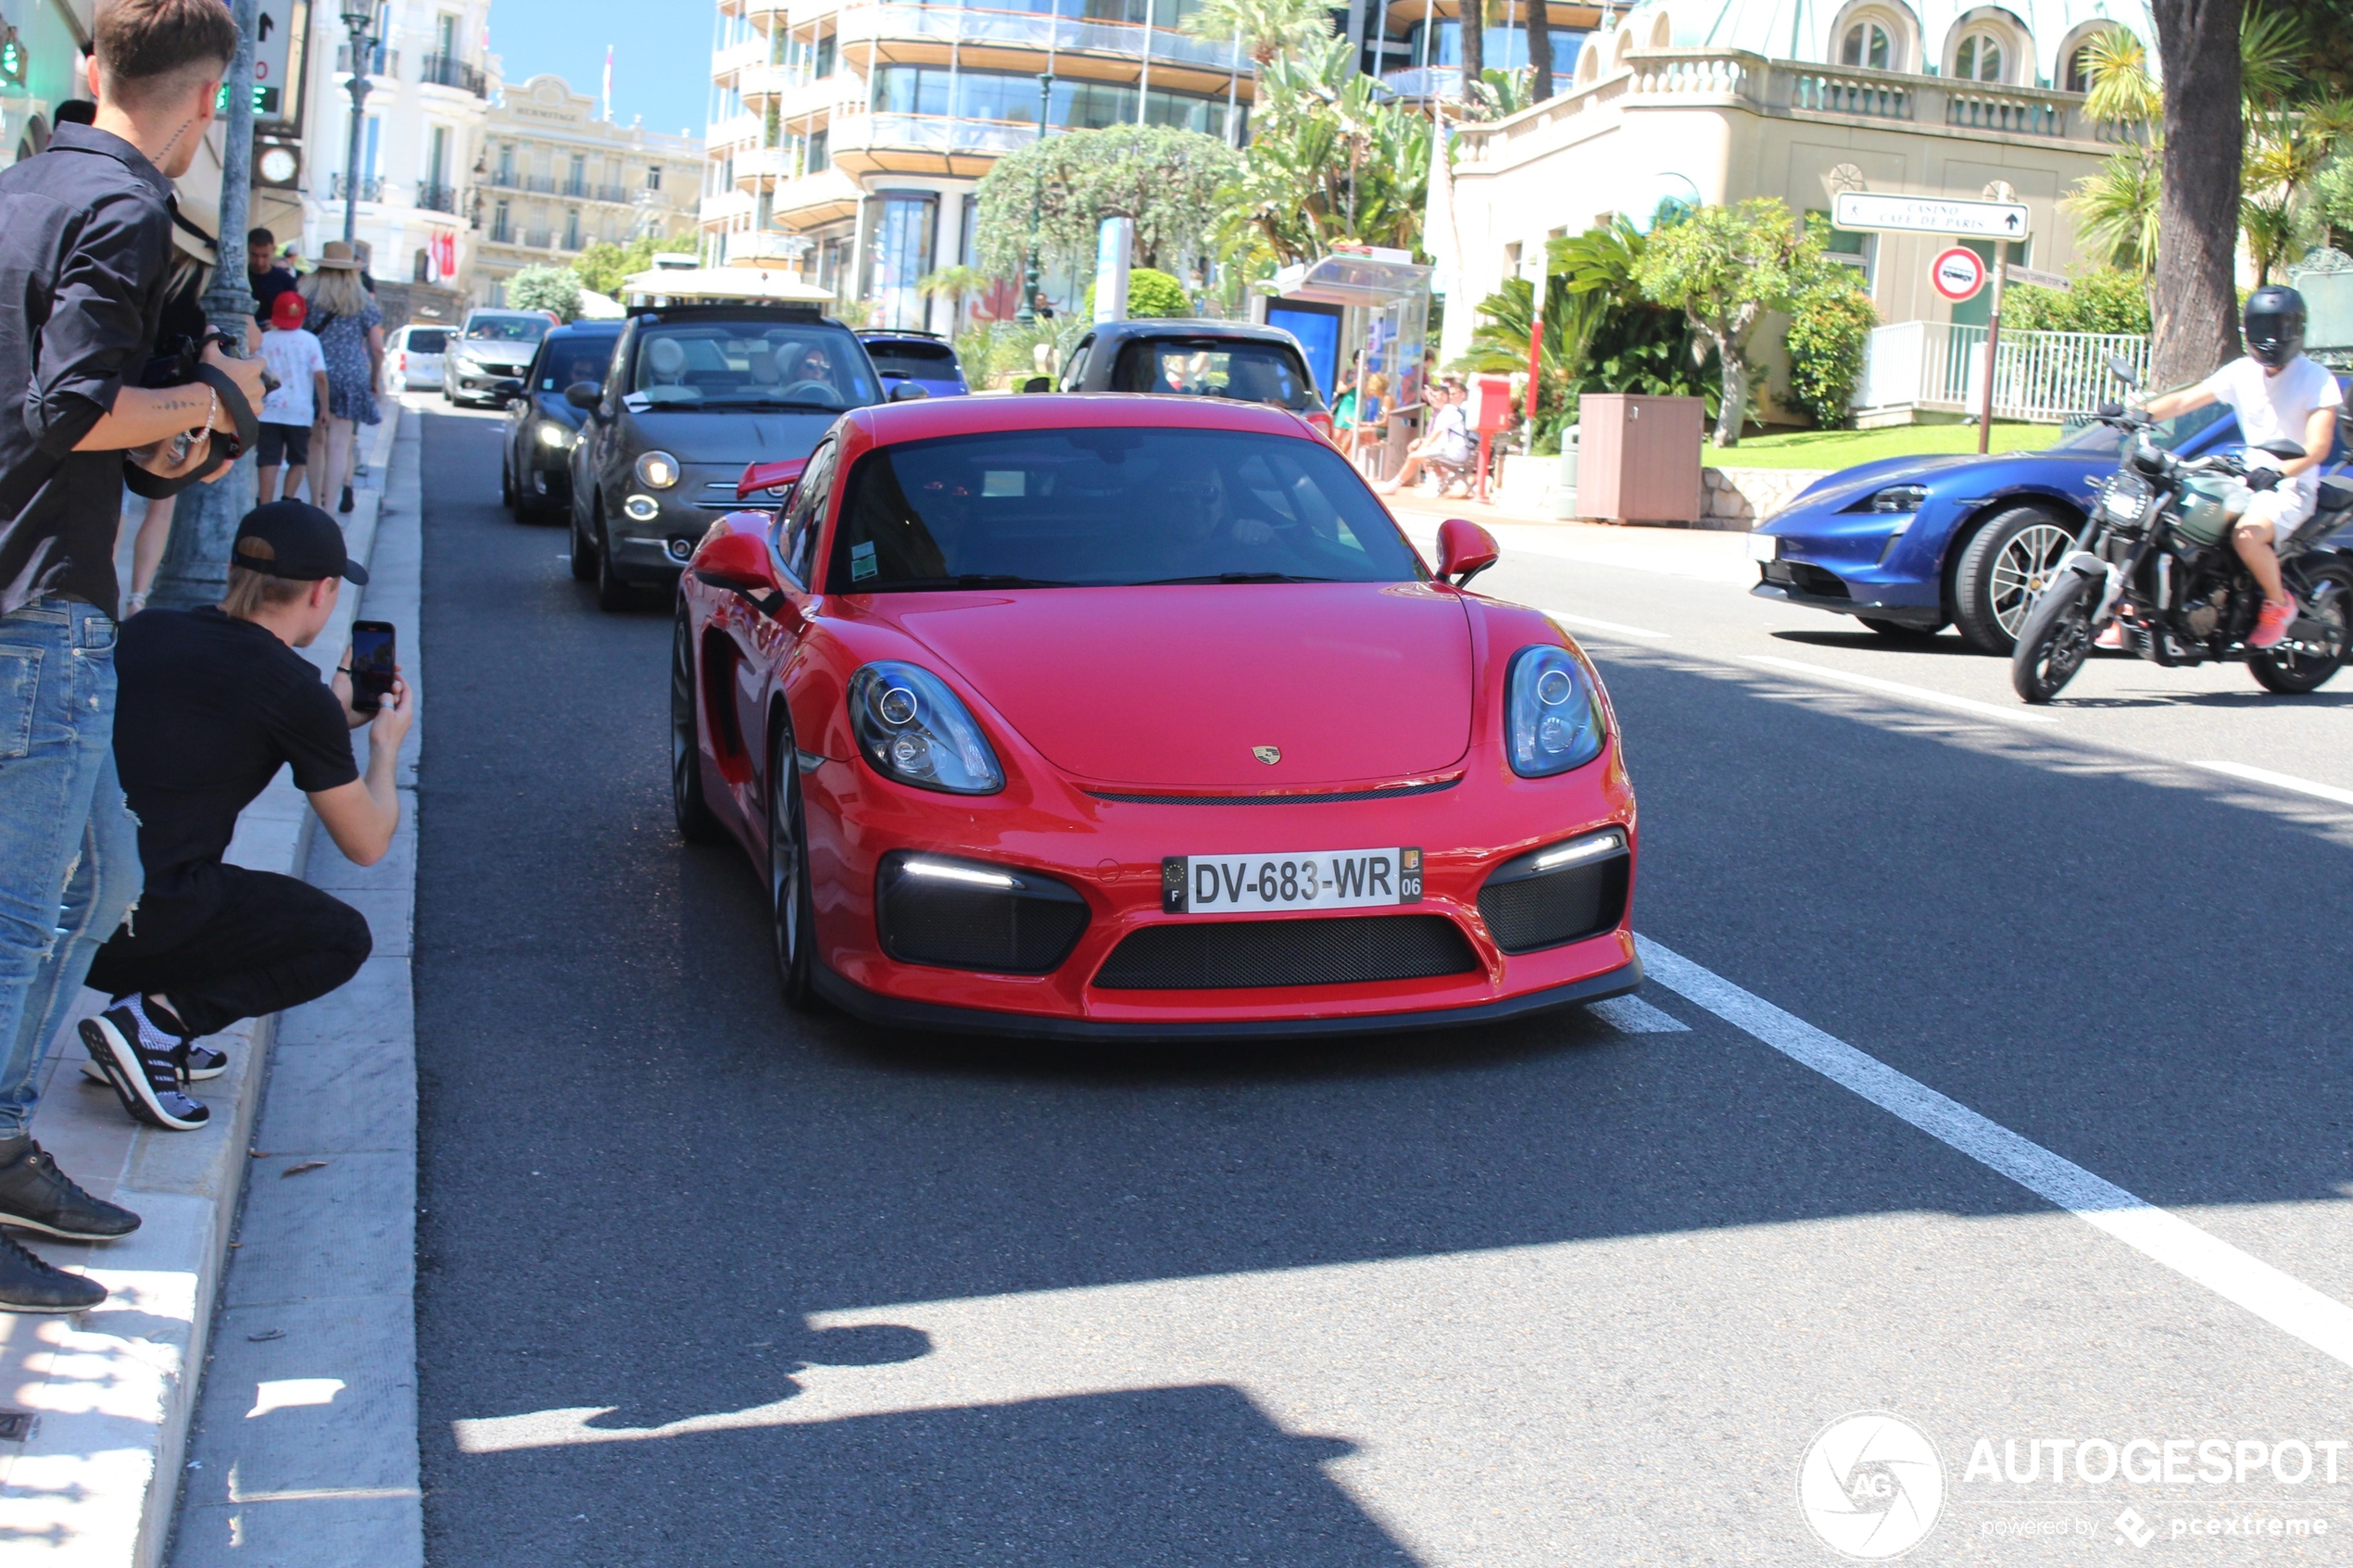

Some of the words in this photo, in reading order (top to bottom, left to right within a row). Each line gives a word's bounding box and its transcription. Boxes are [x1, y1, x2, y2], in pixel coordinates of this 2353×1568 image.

[1907, 203, 1959, 215] CASINO
[1920, 216, 1937, 226] DE
[1946, 219, 1984, 229] PARIS
[1195, 856, 1392, 904] DV-683-WR
[1402, 878, 1421, 897] 06
[1171, 890, 1179, 902] F
